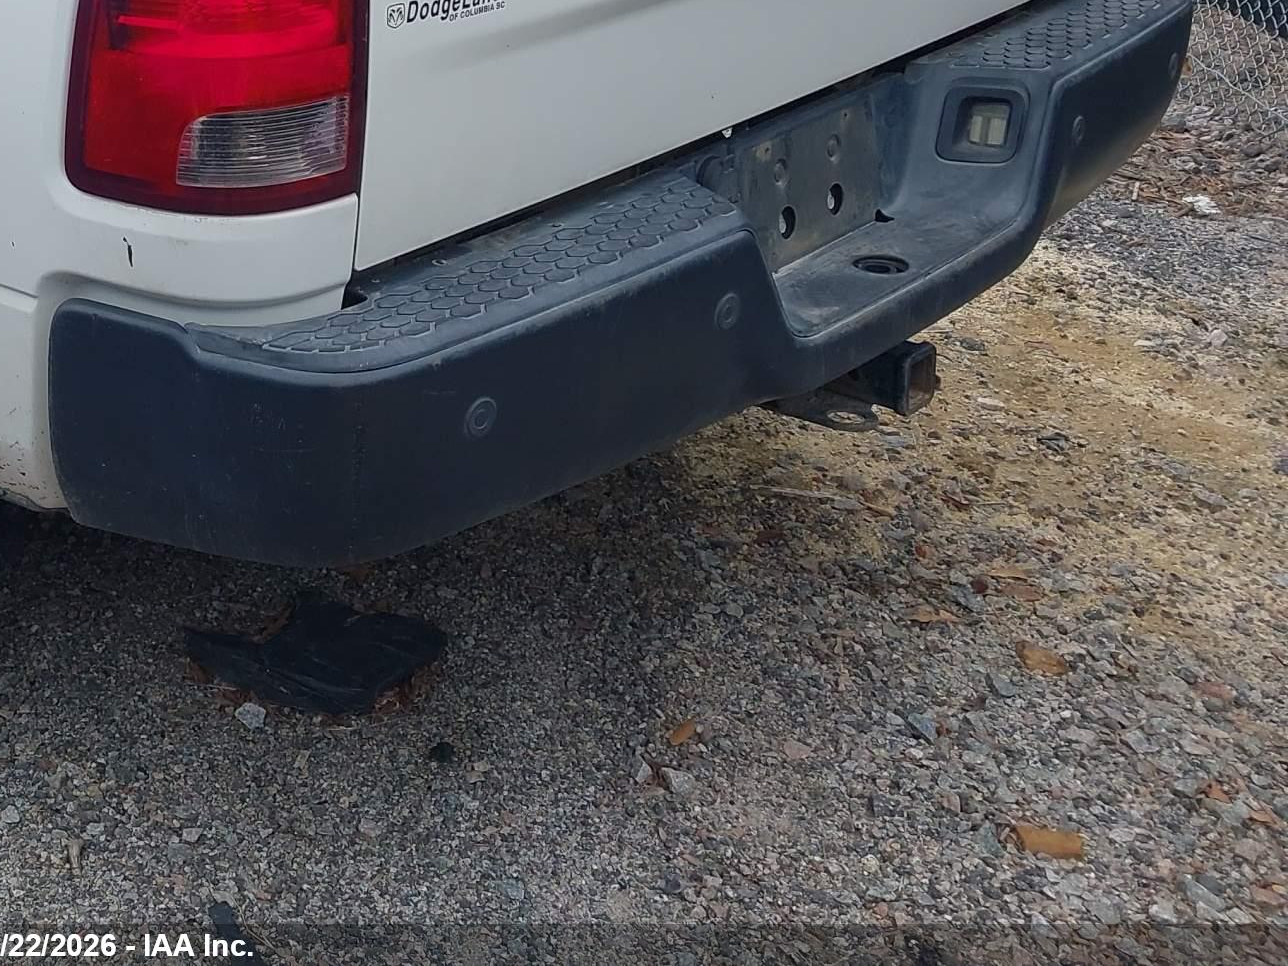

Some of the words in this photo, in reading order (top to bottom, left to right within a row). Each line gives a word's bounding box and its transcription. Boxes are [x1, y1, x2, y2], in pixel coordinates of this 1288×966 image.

[449, 13, 459, 22] OF
[460, 4, 495, 19] COLUMBIA
[496, 1, 505, 10] SC
